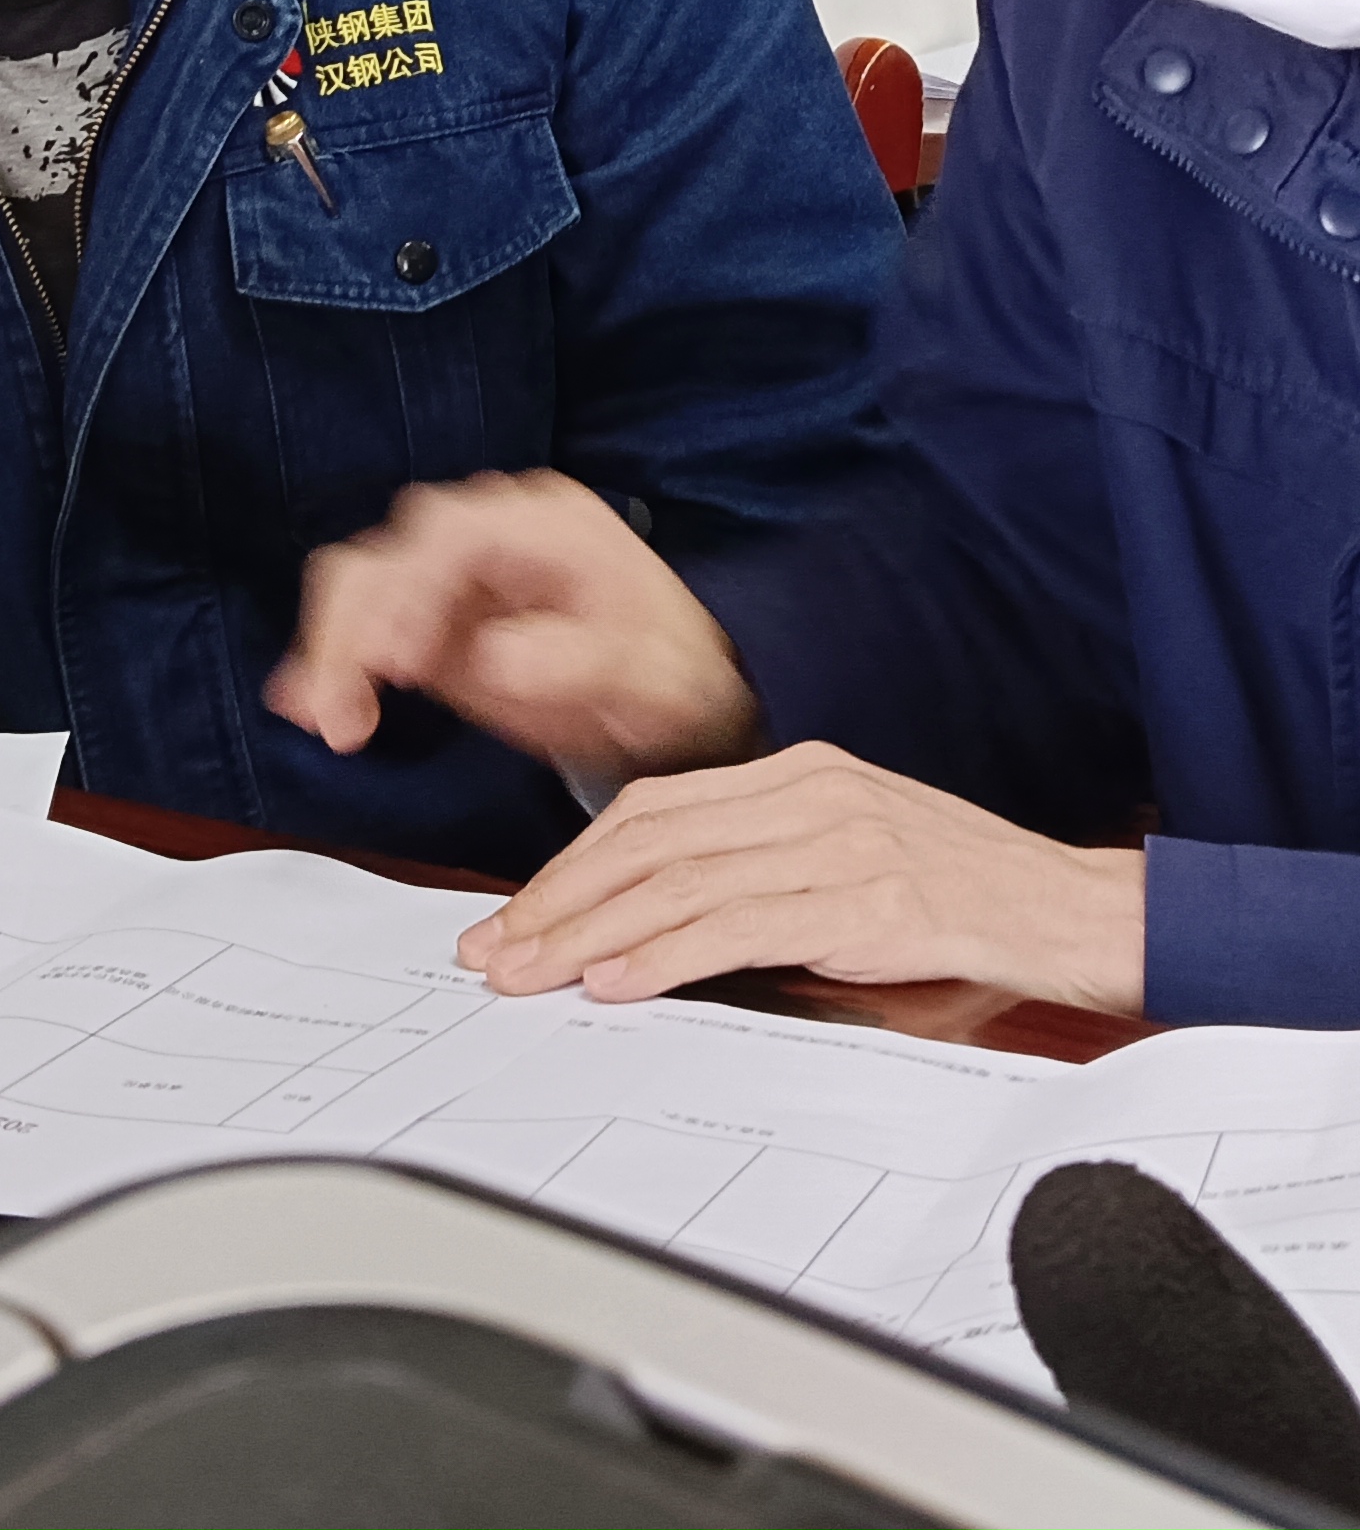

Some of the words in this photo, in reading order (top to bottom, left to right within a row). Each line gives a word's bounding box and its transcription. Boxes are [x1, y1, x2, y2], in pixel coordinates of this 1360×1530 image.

[305, 0, 434, 55] 陕钢集团
[314, 42, 444, 96] 汉钢公司
